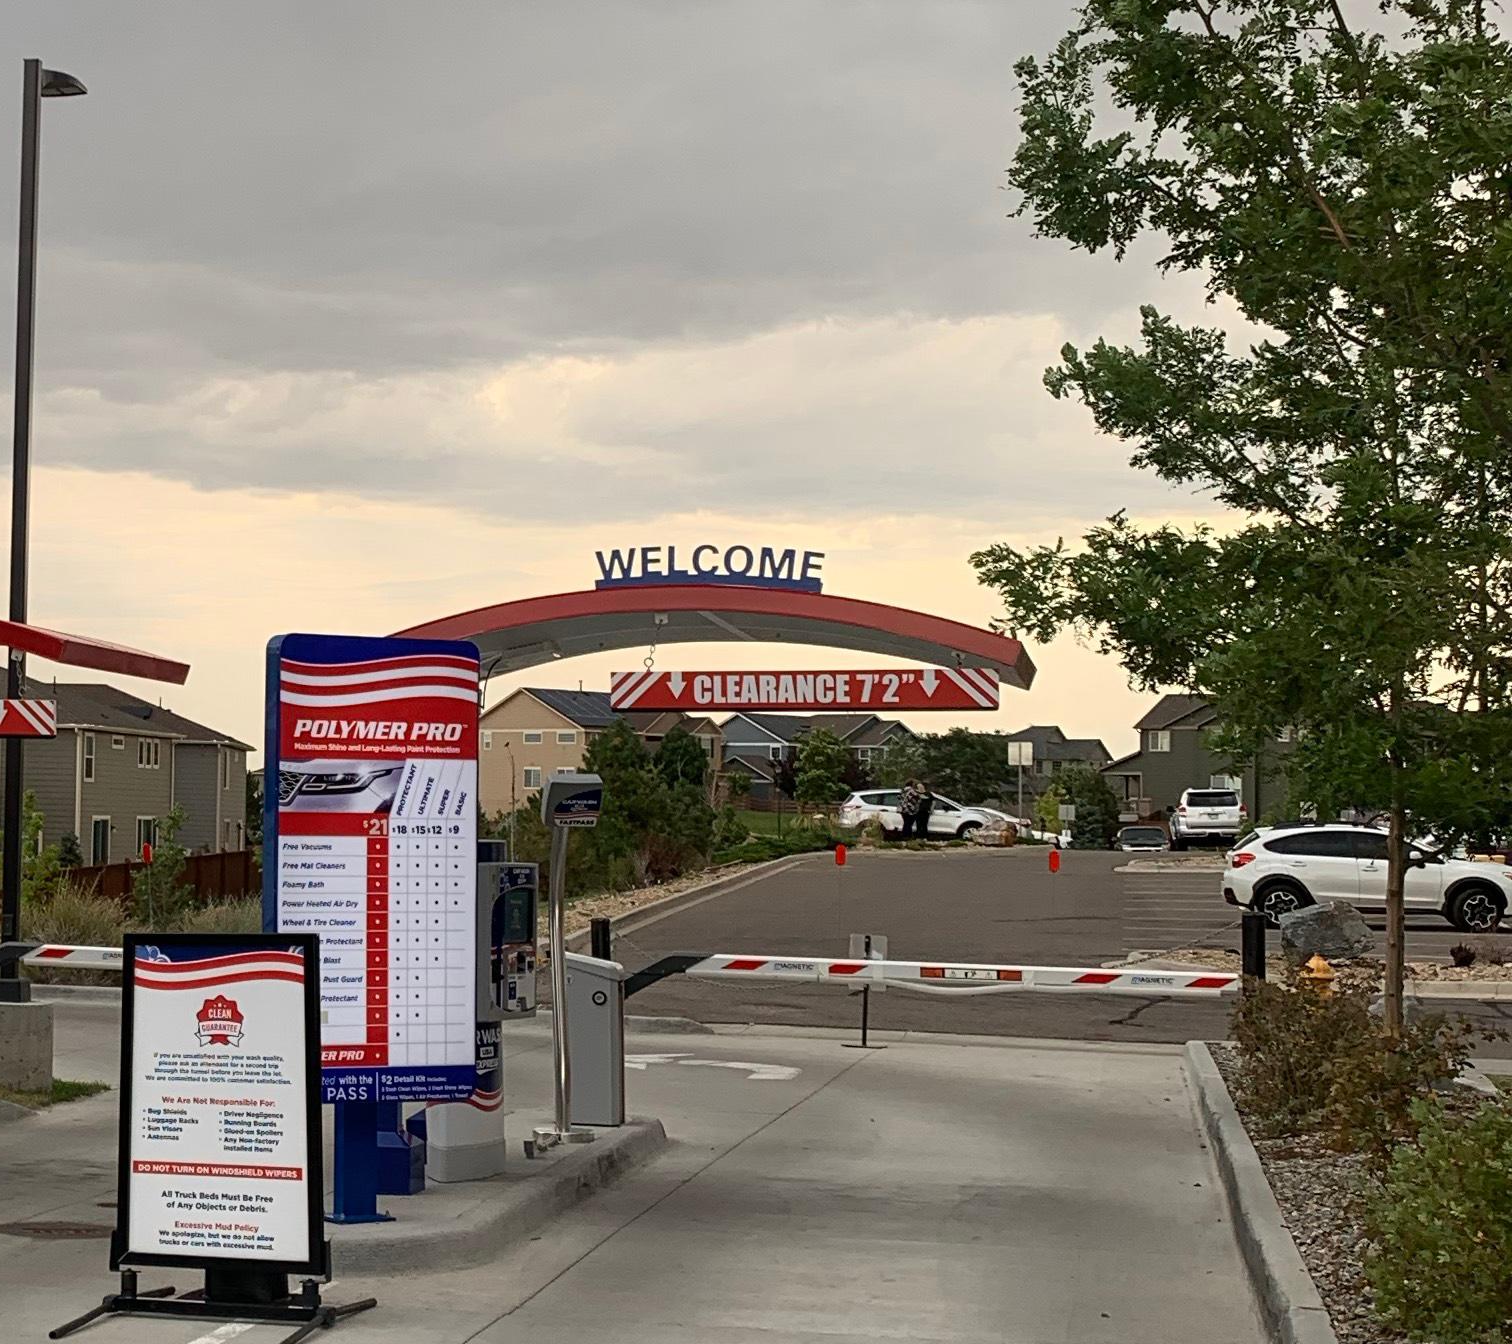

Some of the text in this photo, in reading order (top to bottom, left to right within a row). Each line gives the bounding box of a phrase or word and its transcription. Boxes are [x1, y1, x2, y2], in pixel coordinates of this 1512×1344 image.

[596, 544, 825, 580] WELCOME
[693, 674, 851, 704] CLEARANCE
[294, 719, 463, 741] POLYMER PRO
[294, 742, 327, 750] Maximum
[362, 744, 406, 753] Long-Lasting
[397, 764, 417, 816] PROTECTANT
[418, 777, 434, 816] ULTIMATE
[438, 789, 451, 816] SUPER
[455, 792, 467, 816] BASIC
[363, 819, 387, 835] $21
[392, 826, 407, 834] $18
[412, 826, 426, 834] $15
[428, 826, 442, 834] $12
[449, 826, 459, 834] $9
[208, 1009, 232, 1019] CLEAN
[201, 1023, 238, 1033] GUARANTEE
[338, 1050, 365, 1061] PRO
[338, 1075, 357, 1084] with
[359, 1075, 373, 1084] the
[381, 1075, 392, 1085] $2
[327, 1086, 368, 1100] PASS
[211, 1167, 263, 1176] WINDSHIELD
[265, 1169, 297, 1178] WIPERS
[178, 1202, 193, 1210] Any
[196, 1203, 226, 1211] Objects
[174, 1221, 259, 1233] Excessive Mud Policy
[172, 1231, 206, 1239] apologize,
